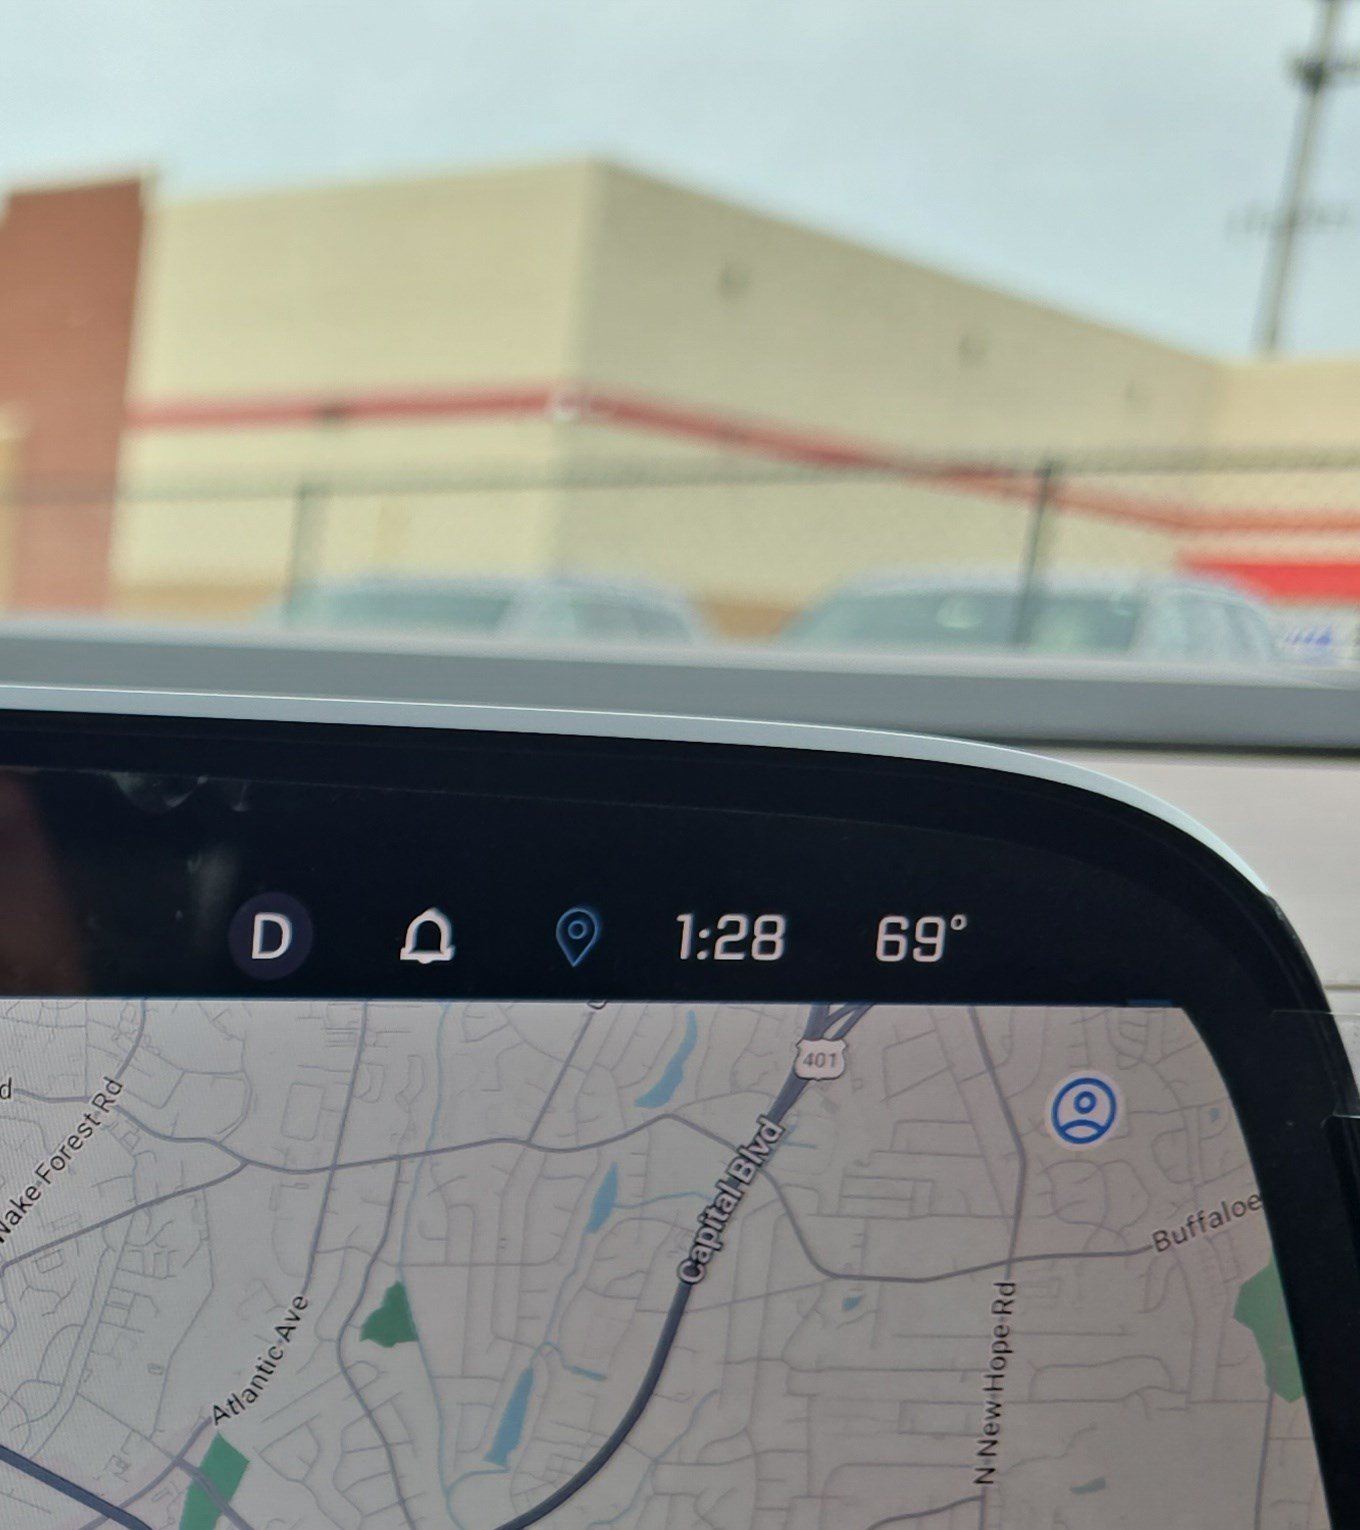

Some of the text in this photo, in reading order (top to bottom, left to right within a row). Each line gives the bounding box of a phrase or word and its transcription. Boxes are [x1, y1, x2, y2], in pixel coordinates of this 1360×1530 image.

[251, 912, 292, 960] D
[676, 914, 786, 960] 1:28
[876, 914, 968, 962] 69°
[802, 1051, 836, 1069] 401
[36, 1114, 101, 1186] Forest
[92, 1078, 124, 1116] Rd
[679, 1115, 785, 1286] Capital Blvd
[1152, 1194, 1262, 1252] Buffaloe
[211, 1293, 309, 1426] Atlantic Ave
[973, 1281, 1016, 1485] N New Hope Rd
